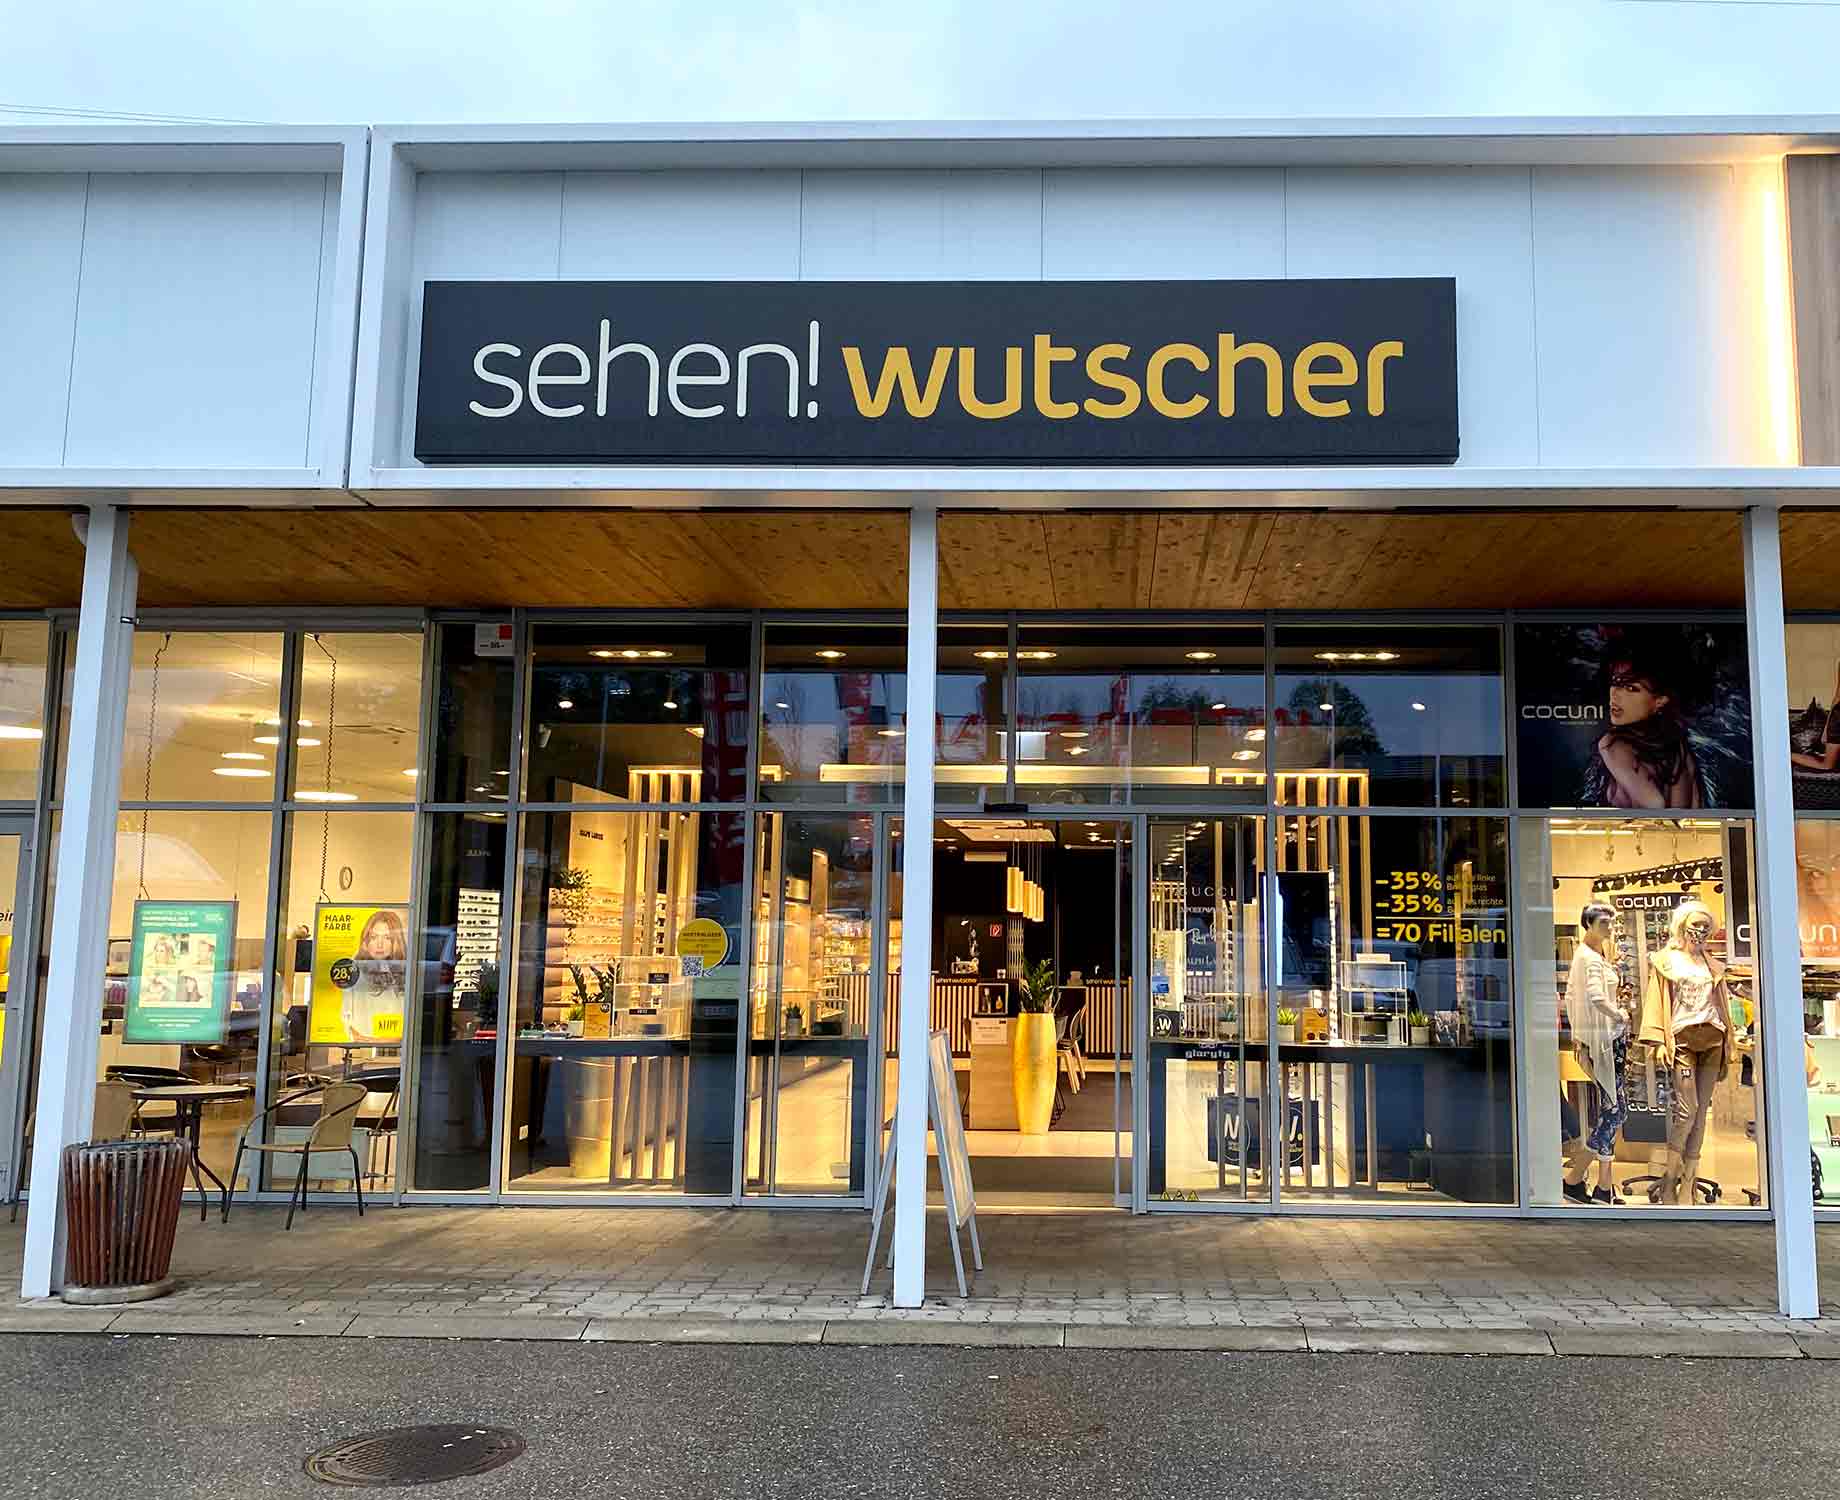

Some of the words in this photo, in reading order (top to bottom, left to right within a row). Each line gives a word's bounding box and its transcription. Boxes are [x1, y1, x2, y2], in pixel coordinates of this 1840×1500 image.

[468, 318, 820, 418] sehen!
[841, 332, 1405, 419] wutscher
[1521, 705, 1603, 719] COCUNI
[325, 923, 352, 931] FARBE
